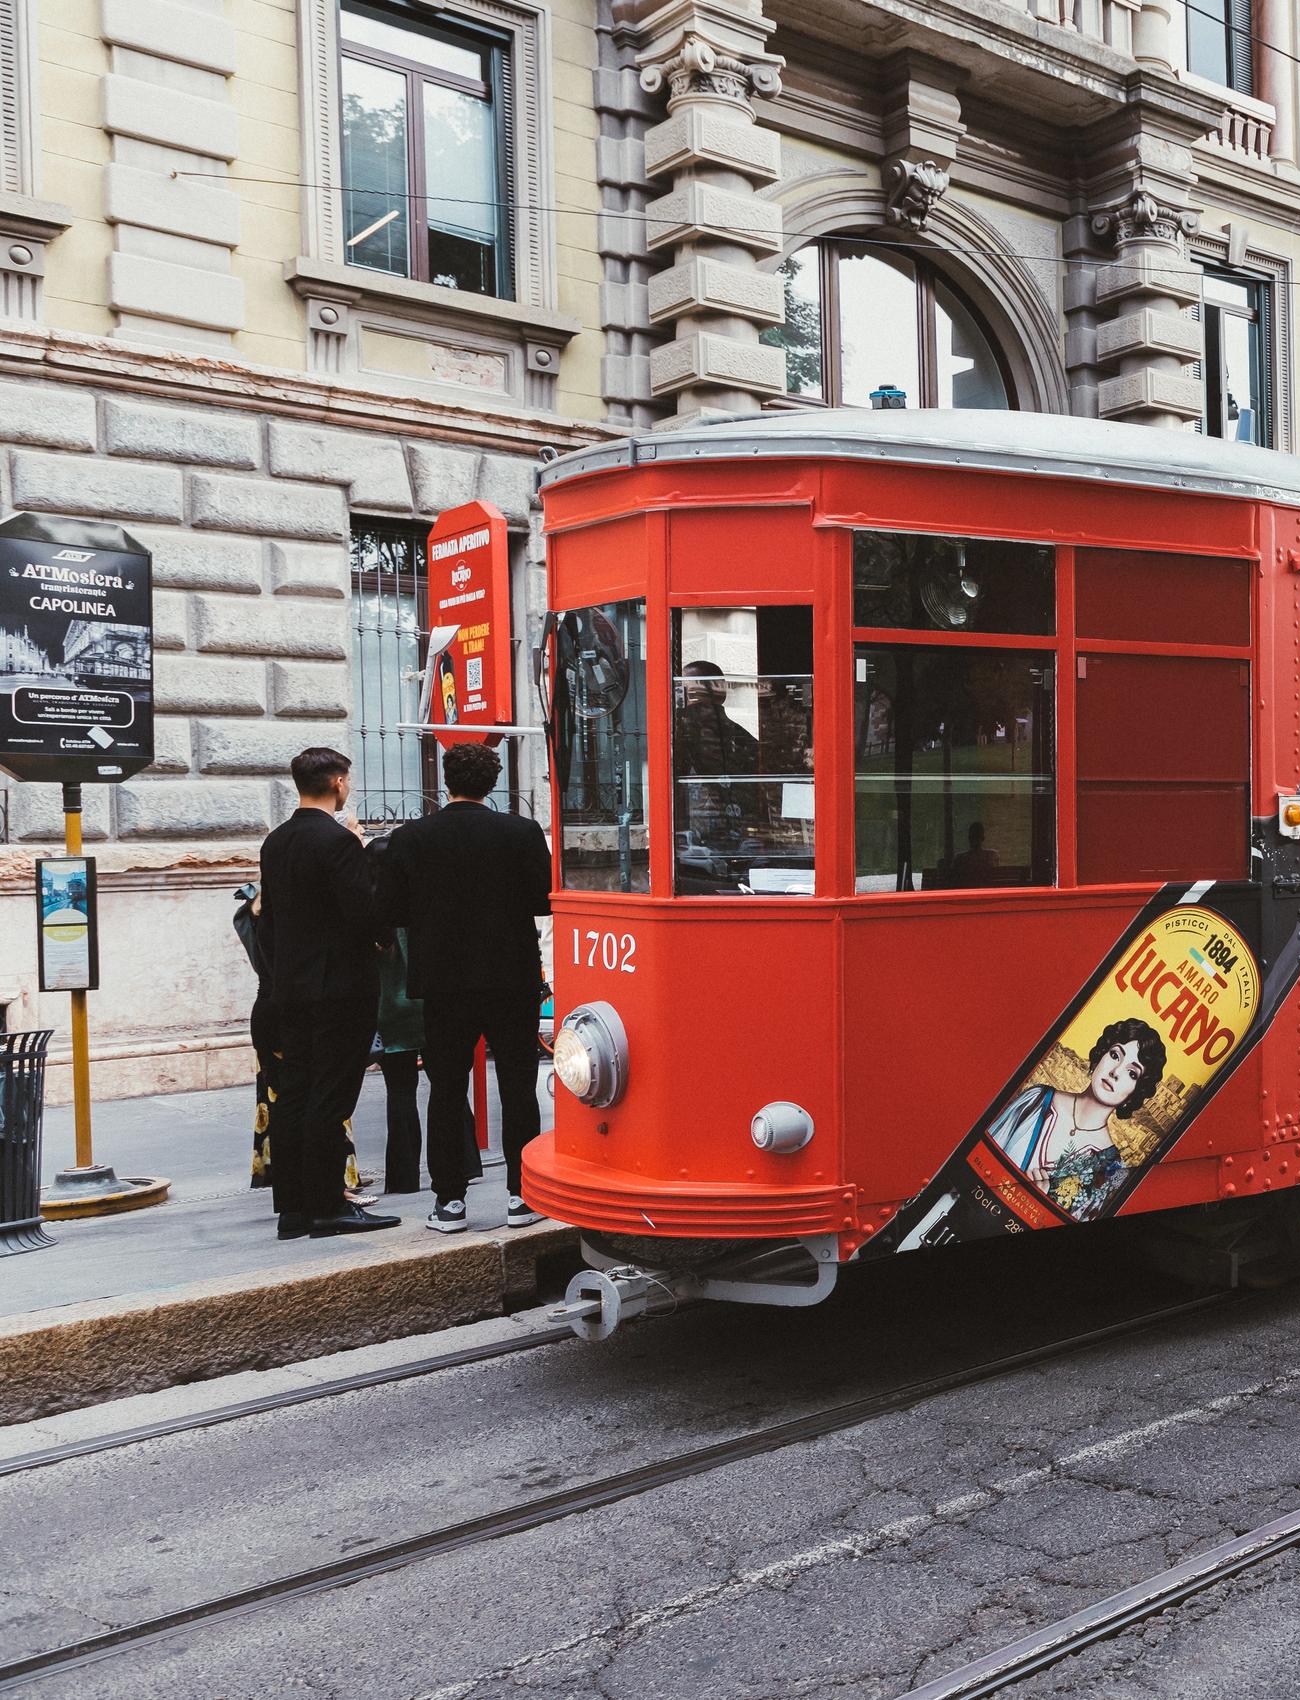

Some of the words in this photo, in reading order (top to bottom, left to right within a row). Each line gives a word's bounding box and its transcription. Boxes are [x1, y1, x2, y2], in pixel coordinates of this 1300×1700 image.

[432, 539, 458, 561] FERMATA
[459, 528, 490, 553] APERITIVO
[21, 563, 123, 589] ATMosfera
[29, 596, 116, 617] CAPOLINEA
[40, 693, 70, 701] percorso
[1165, 919, 1209, 931] PISTICCI
[1224, 933, 1236, 949] DAL
[573, 928, 636, 973] 1702
[1202, 933, 1239, 975] 1894
[1176, 959, 1219, 1005] AMARO
[1240, 966, 1250, 1008] ITALIA
[1115, 932, 1236, 1066] LUCANO
